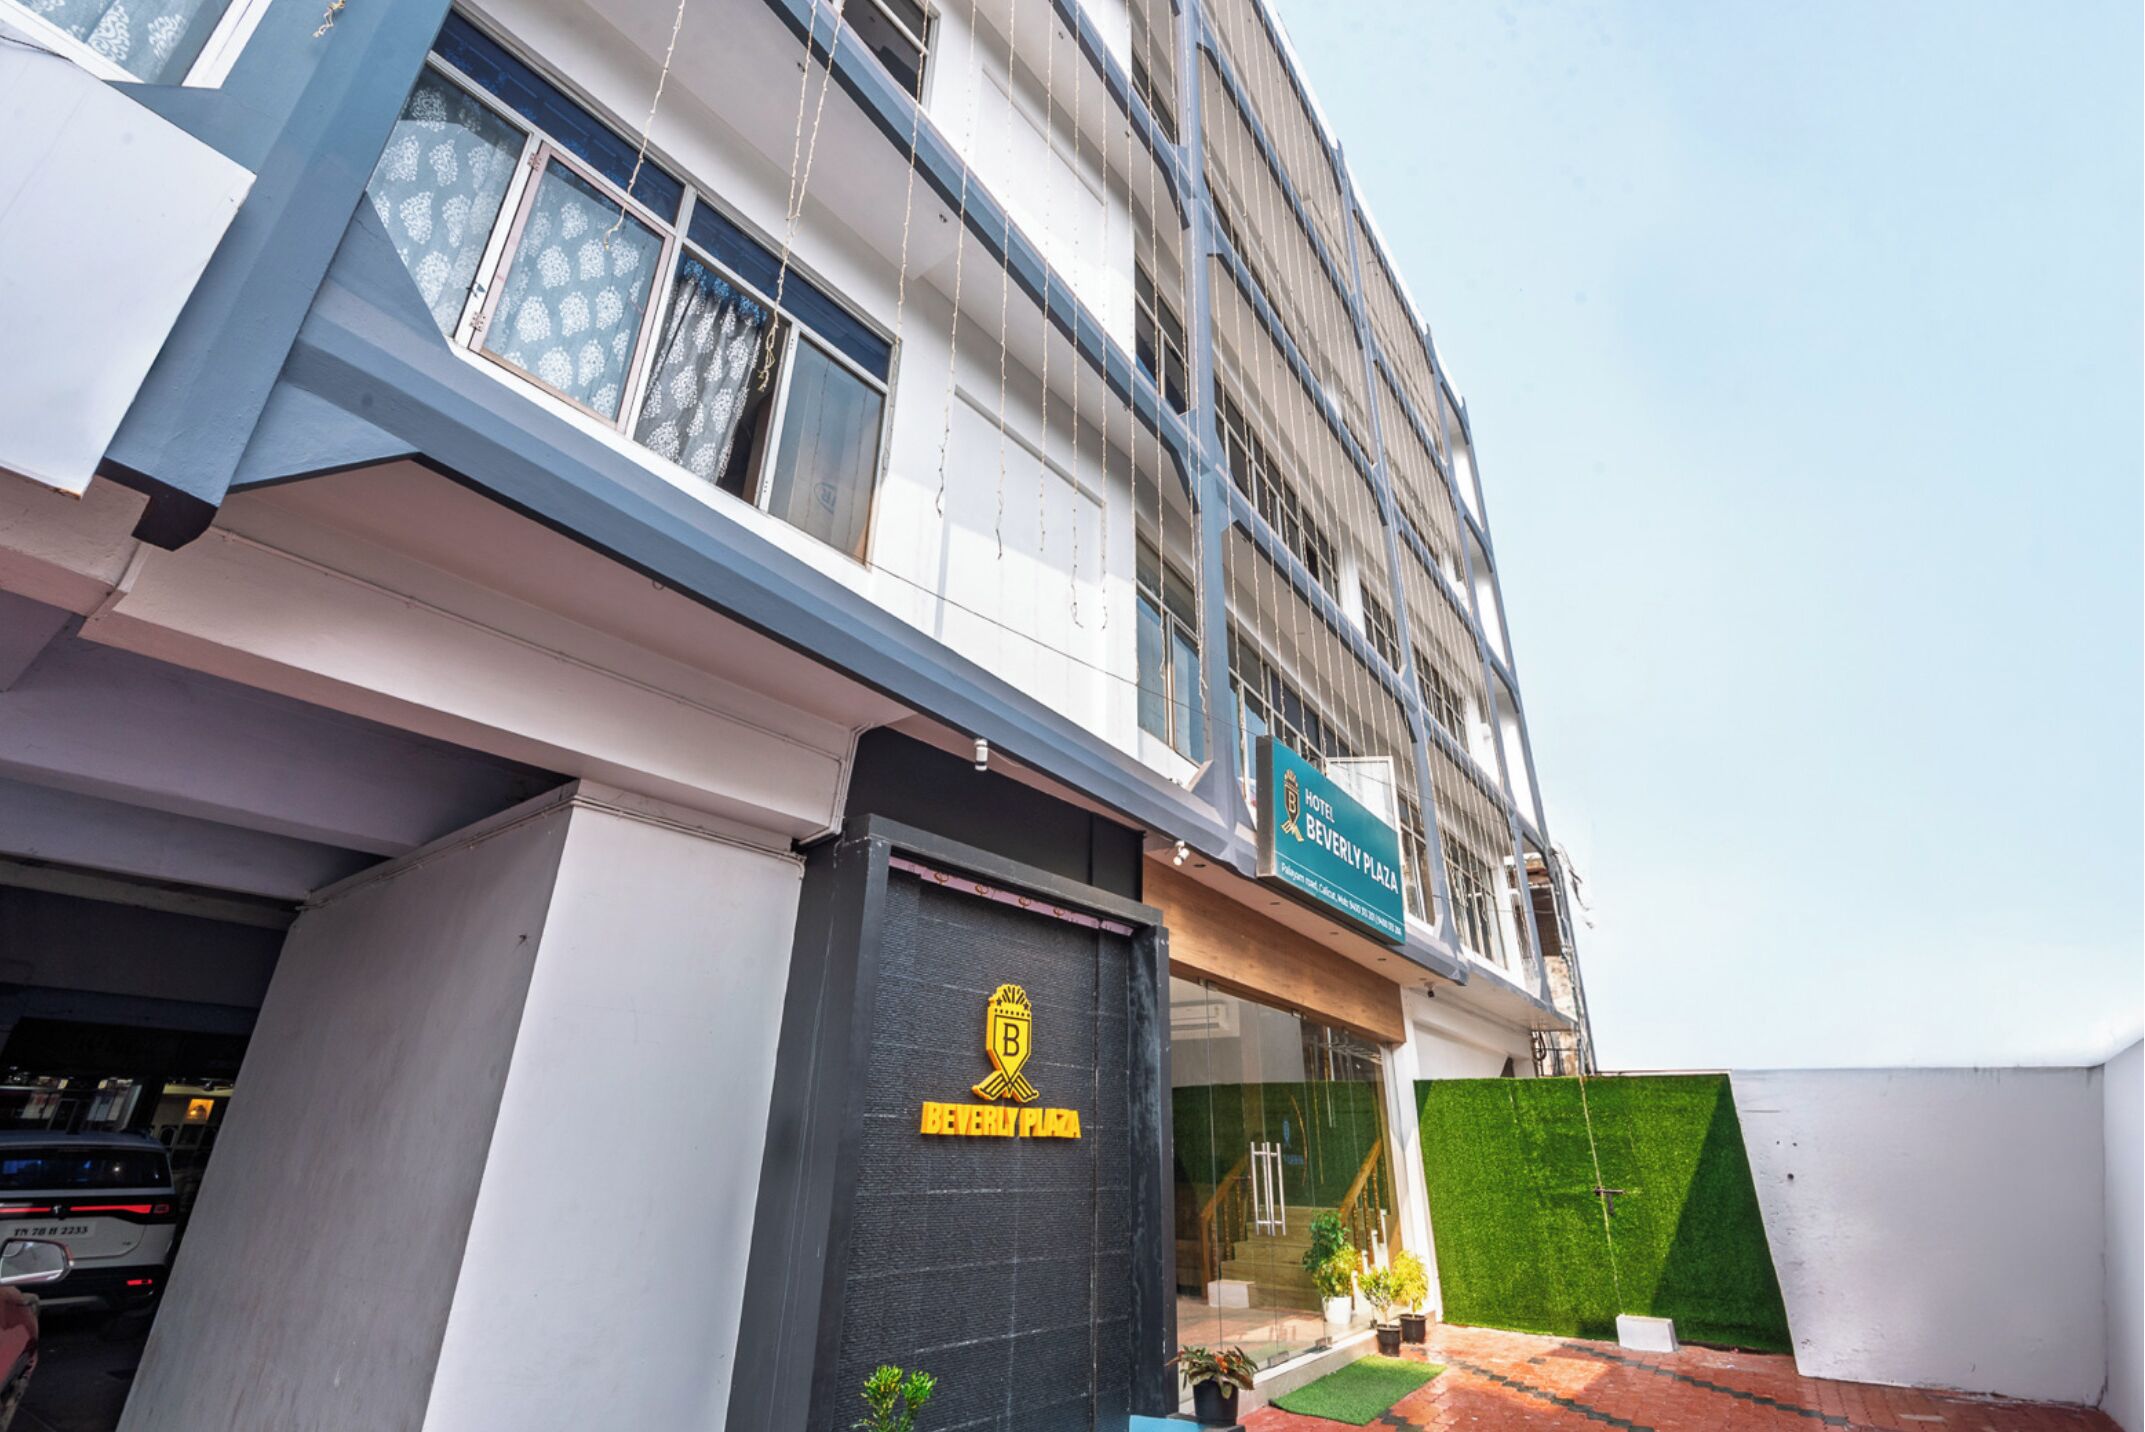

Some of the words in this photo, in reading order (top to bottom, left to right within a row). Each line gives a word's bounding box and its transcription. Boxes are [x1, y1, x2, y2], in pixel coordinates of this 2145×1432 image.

[1305, 788, 1335, 823] HOTEL
[1306, 812, 1361, 870] BEVERLY
[1363, 851, 1399, 895] PLAZA
[1003, 1022, 1020, 1057] B
[920, 1101, 1019, 1137] BEVERLY
[1019, 1107, 1081, 1139] PLAZA
